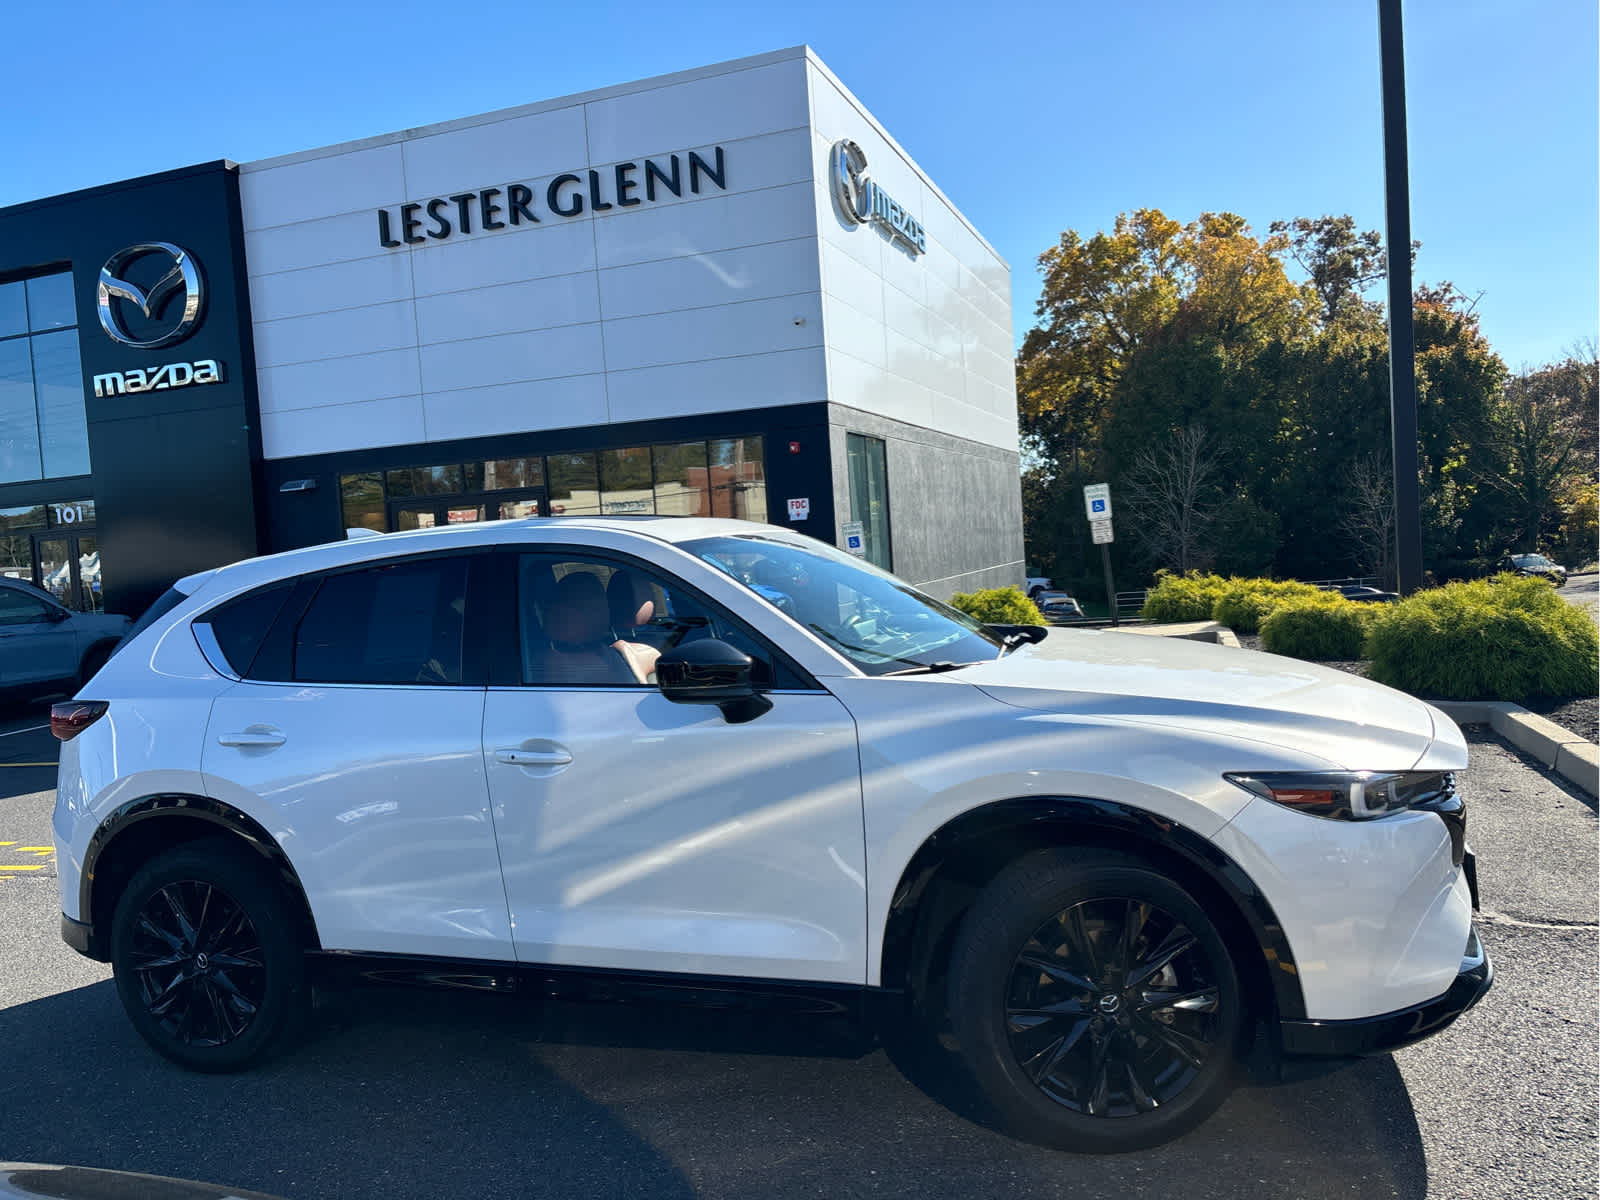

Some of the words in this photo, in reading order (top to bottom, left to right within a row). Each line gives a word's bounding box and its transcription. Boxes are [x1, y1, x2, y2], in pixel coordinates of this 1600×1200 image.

[378, 184, 541, 248] LESTER
[546, 146, 726, 217] GLENN
[55, 505, 83, 524] 101
[790, 500, 807, 510] FDC
